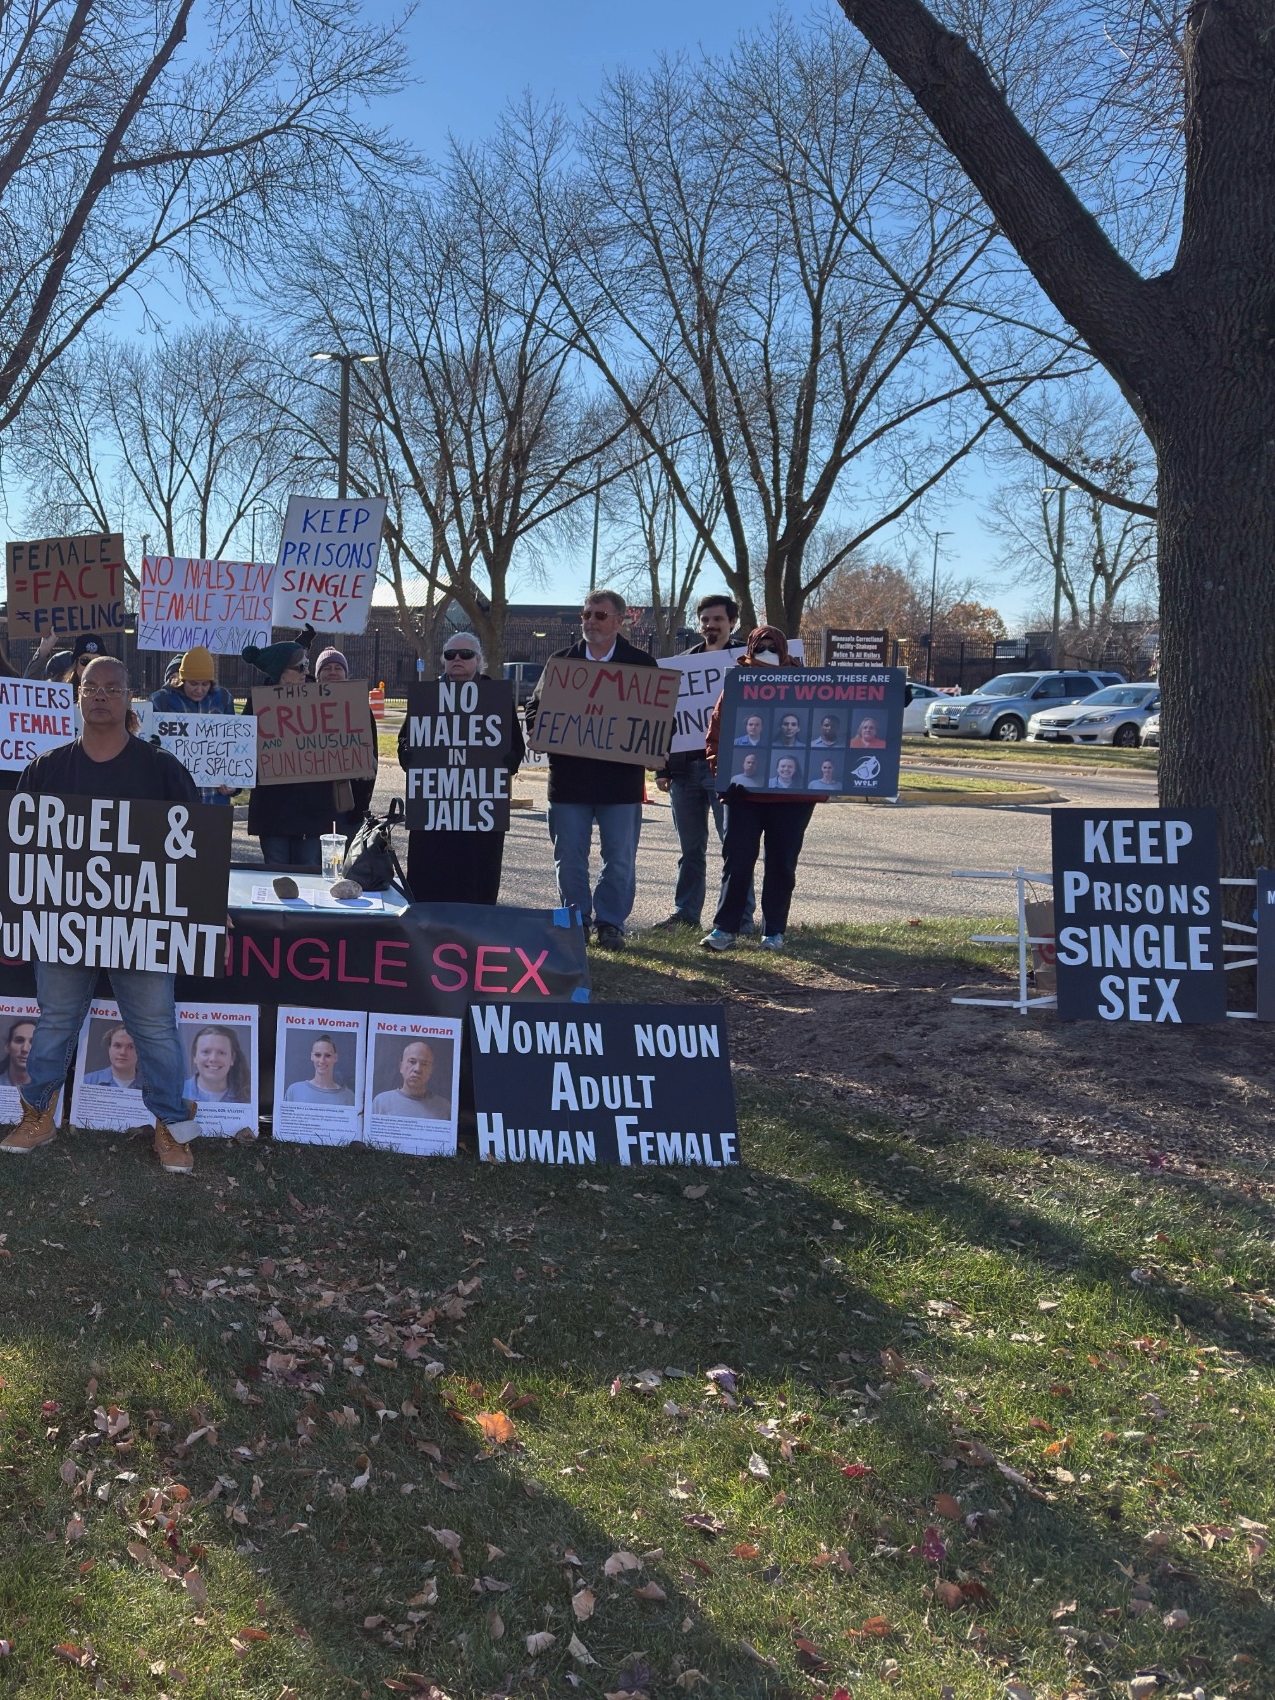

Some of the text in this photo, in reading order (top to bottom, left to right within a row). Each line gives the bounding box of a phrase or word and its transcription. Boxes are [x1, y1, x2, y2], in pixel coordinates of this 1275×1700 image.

[302, 508, 370, 533] KEEP
[12, 538, 111, 574] FEMALE
[282, 542, 376, 569] PRISONS
[142, 556, 274, 592] NO MALES IN
[281, 570, 366, 598] SINGLE
[141, 590, 273, 622] FEMALE JAILS
[293, 598, 347, 623] SEX
[273, 684, 331, 699] THIS IS
[549, 665, 588, 690] NO
[589, 668, 675, 708] MALE
[738, 674, 890, 684] HEY CORRECTIONS, THESE ARE
[743, 684, 885, 701] NOT WOMEN
[438, 681, 479, 713] NO
[585, 704, 603, 715] IN
[9, 712, 73, 737] FEMALE
[158, 722, 189, 737] SEX
[195, 723, 254, 738] MATTERS.
[256, 701, 364, 739] CRUEL
[409, 714, 502, 747] MALES
[536, 711, 617, 750] FEMALE
[619, 717, 667, 756] JAIL
[175, 739, 237, 757] PROTECT
[262, 733, 368, 751] AND UNUSUAL
[448, 748, 467, 765] IN
[205, 757, 254, 778] SPACES
[260, 744, 374, 777] PUNISHMENT
[408, 767, 509, 799] FEMALE
[425, 800, 495, 832] JAILS
[164, 805, 197, 860] &
[1084, 819, 1193, 864] KEEP
[1063, 870, 1210, 916] PRISONS
[1057, 924, 1214, 971] SINGLE
[430, 942, 551, 996] SEX
[90, 1007, 109, 1016] Not
[1098, 974, 1182, 1024] SEX
[179, 1011, 199, 1020] Not
[211, 1012, 251, 1022] Woman
[285, 1016, 306, 1025] Not
[317, 1018, 360, 1028] Woman
[377, 1022, 398, 1032] Not
[410, 1024, 454, 1035] Woman
[470, 1005, 720, 1058] WOMAN NOUN
[551, 1061, 656, 1112] ADULT
[476, 1112, 596, 1165] HUMAN
[615, 1115, 740, 1167] FEMALE
